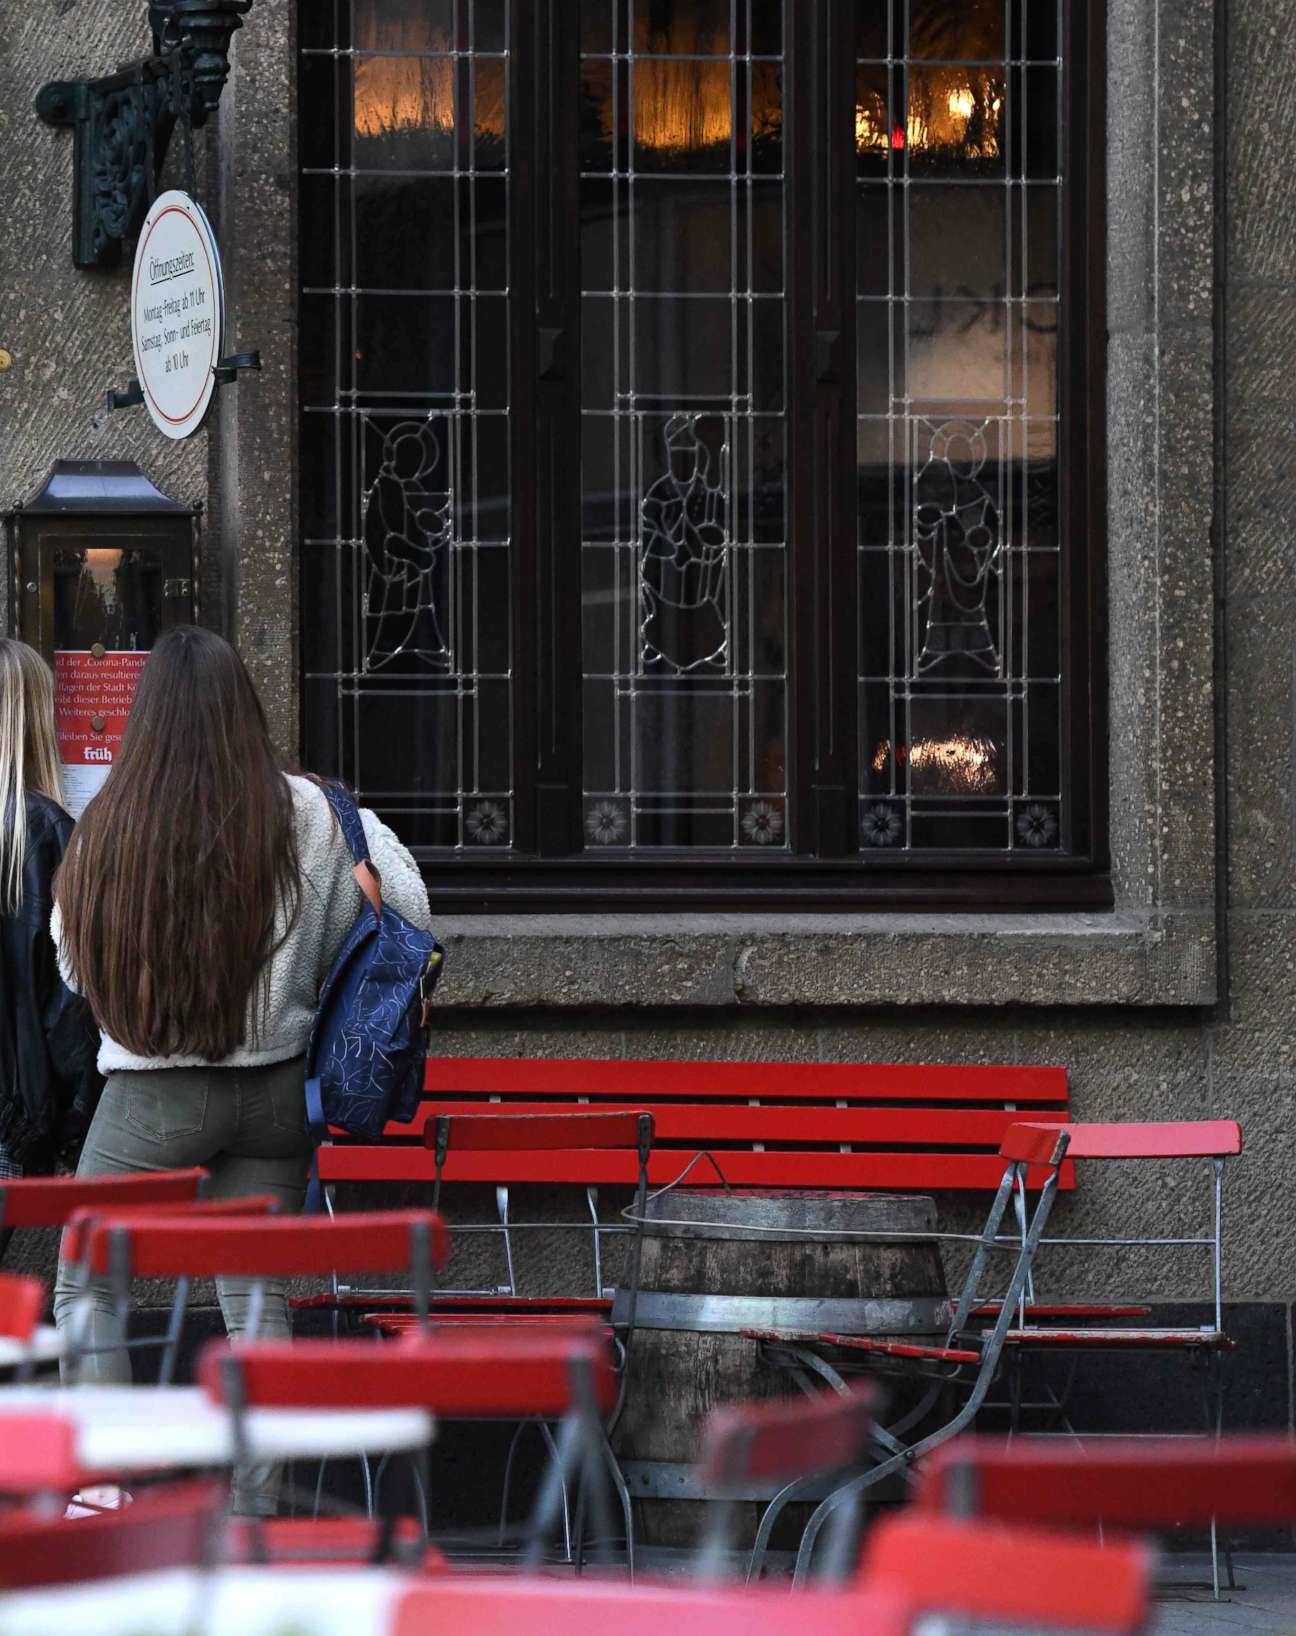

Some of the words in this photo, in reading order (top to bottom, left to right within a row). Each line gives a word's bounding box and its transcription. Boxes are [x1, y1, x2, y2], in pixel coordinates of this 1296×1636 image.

[182, 291, 189, 310] ab
[190, 290, 195, 307] 11
[196, 287, 205, 306] Uhr
[180, 320, 190, 339] und
[191, 318, 211, 337] Feiertag
[165, 355, 171, 373] ab
[173, 353, 179, 370] 10
[179, 350, 189, 369] Uhr
[67, 658, 80, 667] der
[70, 671, 99, 679] daraus
[86, 683, 101, 692] der
[103, 683, 125, 692] Stadt
[73, 695, 99, 704] dieser
[101, 695, 133, 704] Betrieb
[59, 707, 97, 717] Weiteres
[89, 732, 103, 741] Sie
